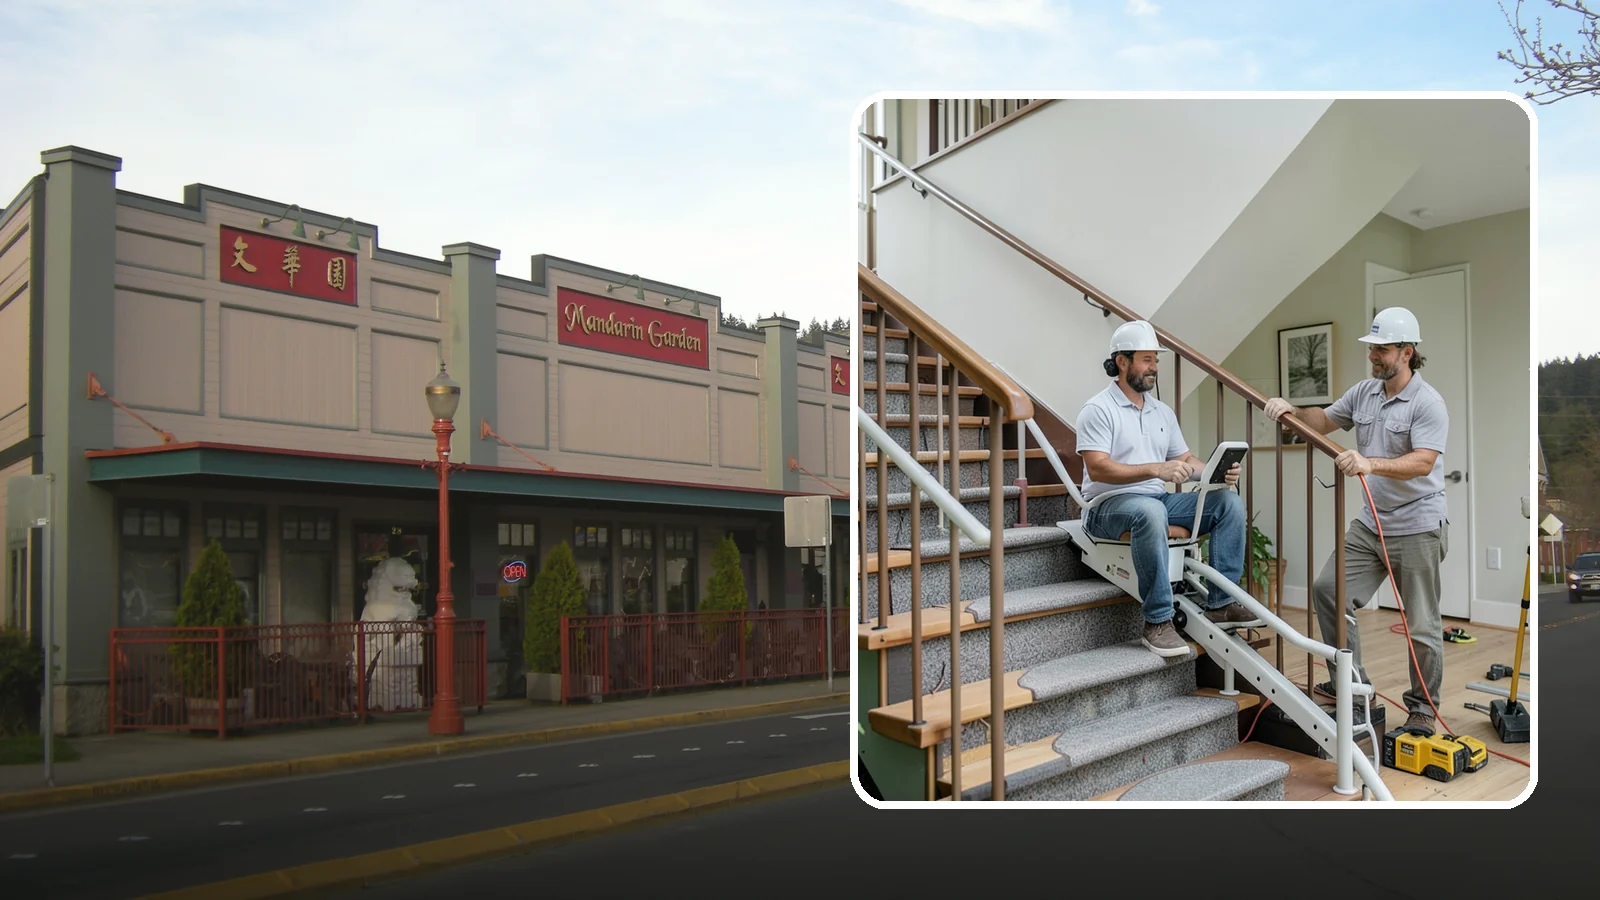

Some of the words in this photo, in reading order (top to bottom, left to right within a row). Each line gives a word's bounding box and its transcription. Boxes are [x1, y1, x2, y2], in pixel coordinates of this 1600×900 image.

[231, 236, 346, 291] 文華園
[565, 302, 644, 341] Mandarin
[648, 320, 701, 352] Garden
[503, 565, 527, 578] OPEN
